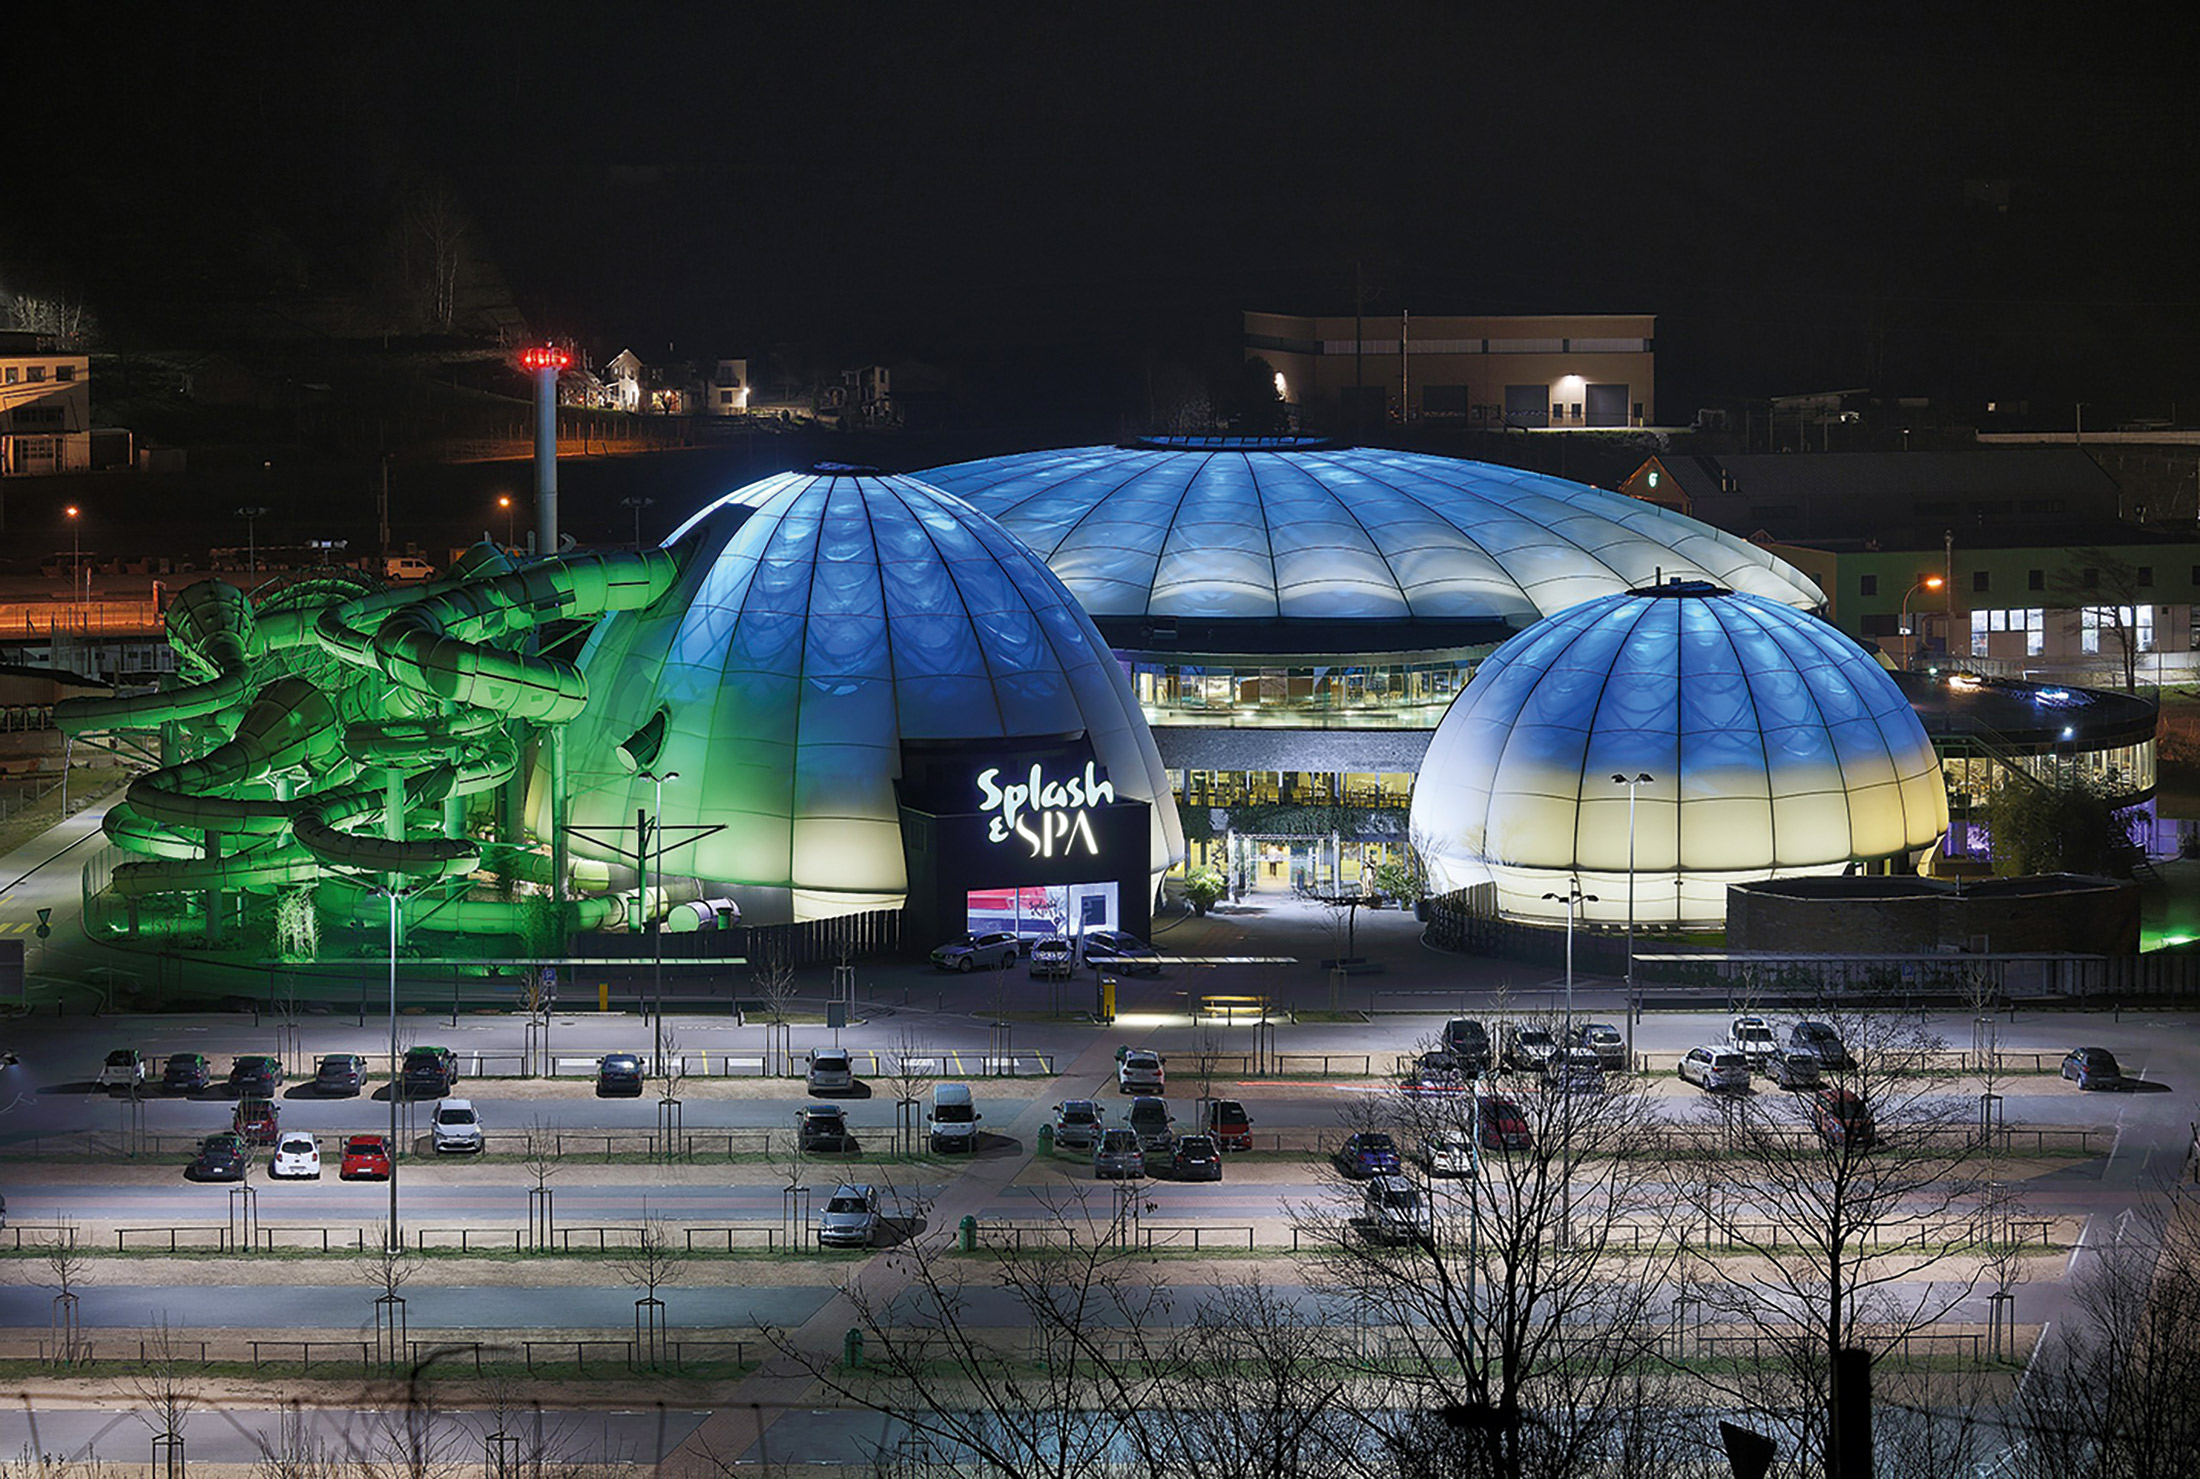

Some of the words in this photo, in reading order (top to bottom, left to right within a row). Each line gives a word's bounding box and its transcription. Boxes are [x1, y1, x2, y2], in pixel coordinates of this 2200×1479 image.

[977, 761, 1114, 829] Splash
[988, 815, 1009, 843] &
[1016, 809, 1099, 858] SPA
